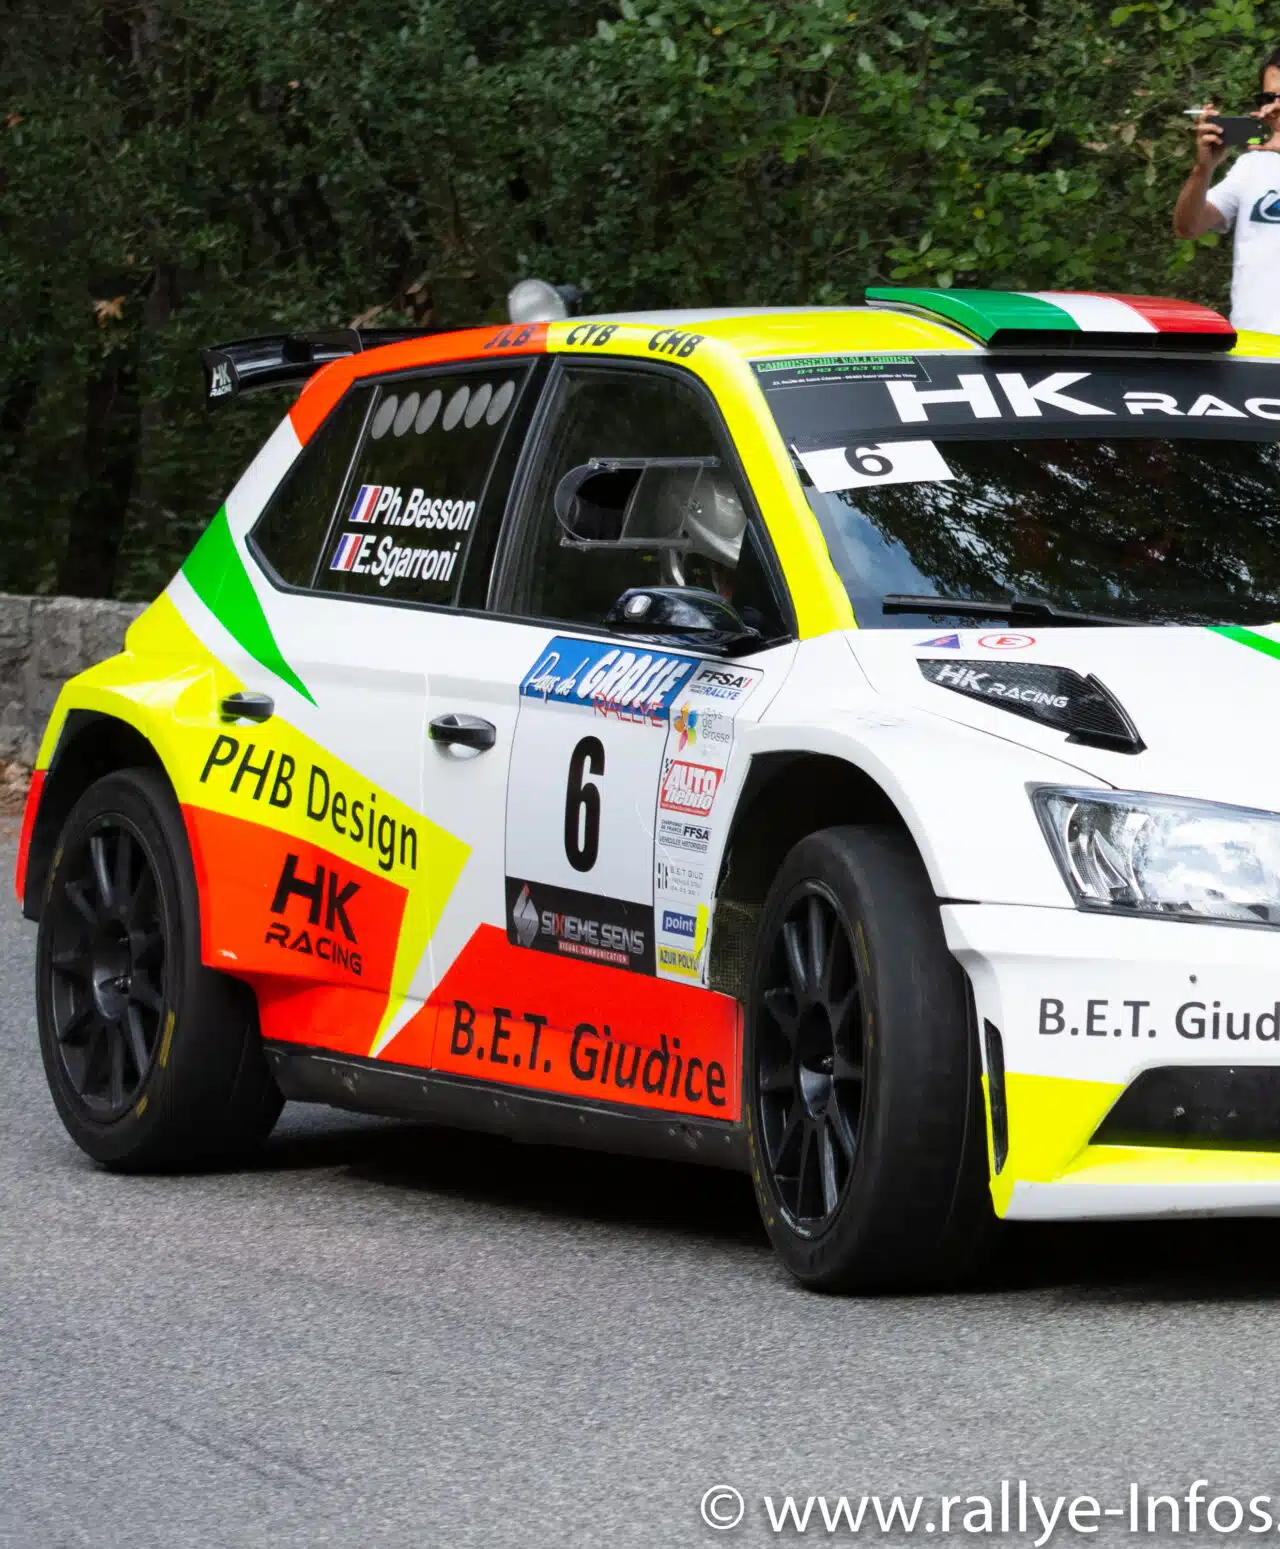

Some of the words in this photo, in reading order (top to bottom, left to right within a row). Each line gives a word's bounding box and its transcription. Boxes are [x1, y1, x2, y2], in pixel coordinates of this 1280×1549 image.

[566, 323, 620, 347] CYB
[648, 329, 704, 358] CHB
[212, 362, 231, 388] HK
[886, 372, 1117, 423] HK
[845, 442, 894, 478] 6
[371, 486, 476, 531] Ph.Besson
[352, 535, 461, 587] E.Sgarroni
[697, 670, 744, 688] FFSA
[703, 687, 740, 701] RALLYE
[936, 664, 991, 692] HK
[987, 682, 1069, 708] RACING
[592, 692, 665, 728] RALLYE
[665, 763, 717, 797] AUTO
[199, 734, 295, 809] PHB
[306, 764, 417, 872] Design
[564, 735, 606, 873] 6
[683, 826, 709, 840] FFSA
[270, 853, 361, 945] HK
[541, 911, 599, 945] SIXIEME
[600, 923, 645, 955] SENS
[665, 915, 694, 931] point
[264, 922, 362, 977] RACING
[1038, 998, 1156, 1038] B.E.T.
[450, 1000, 551, 1073] B.E.T.
[569, 1022, 726, 1107] Giudice
